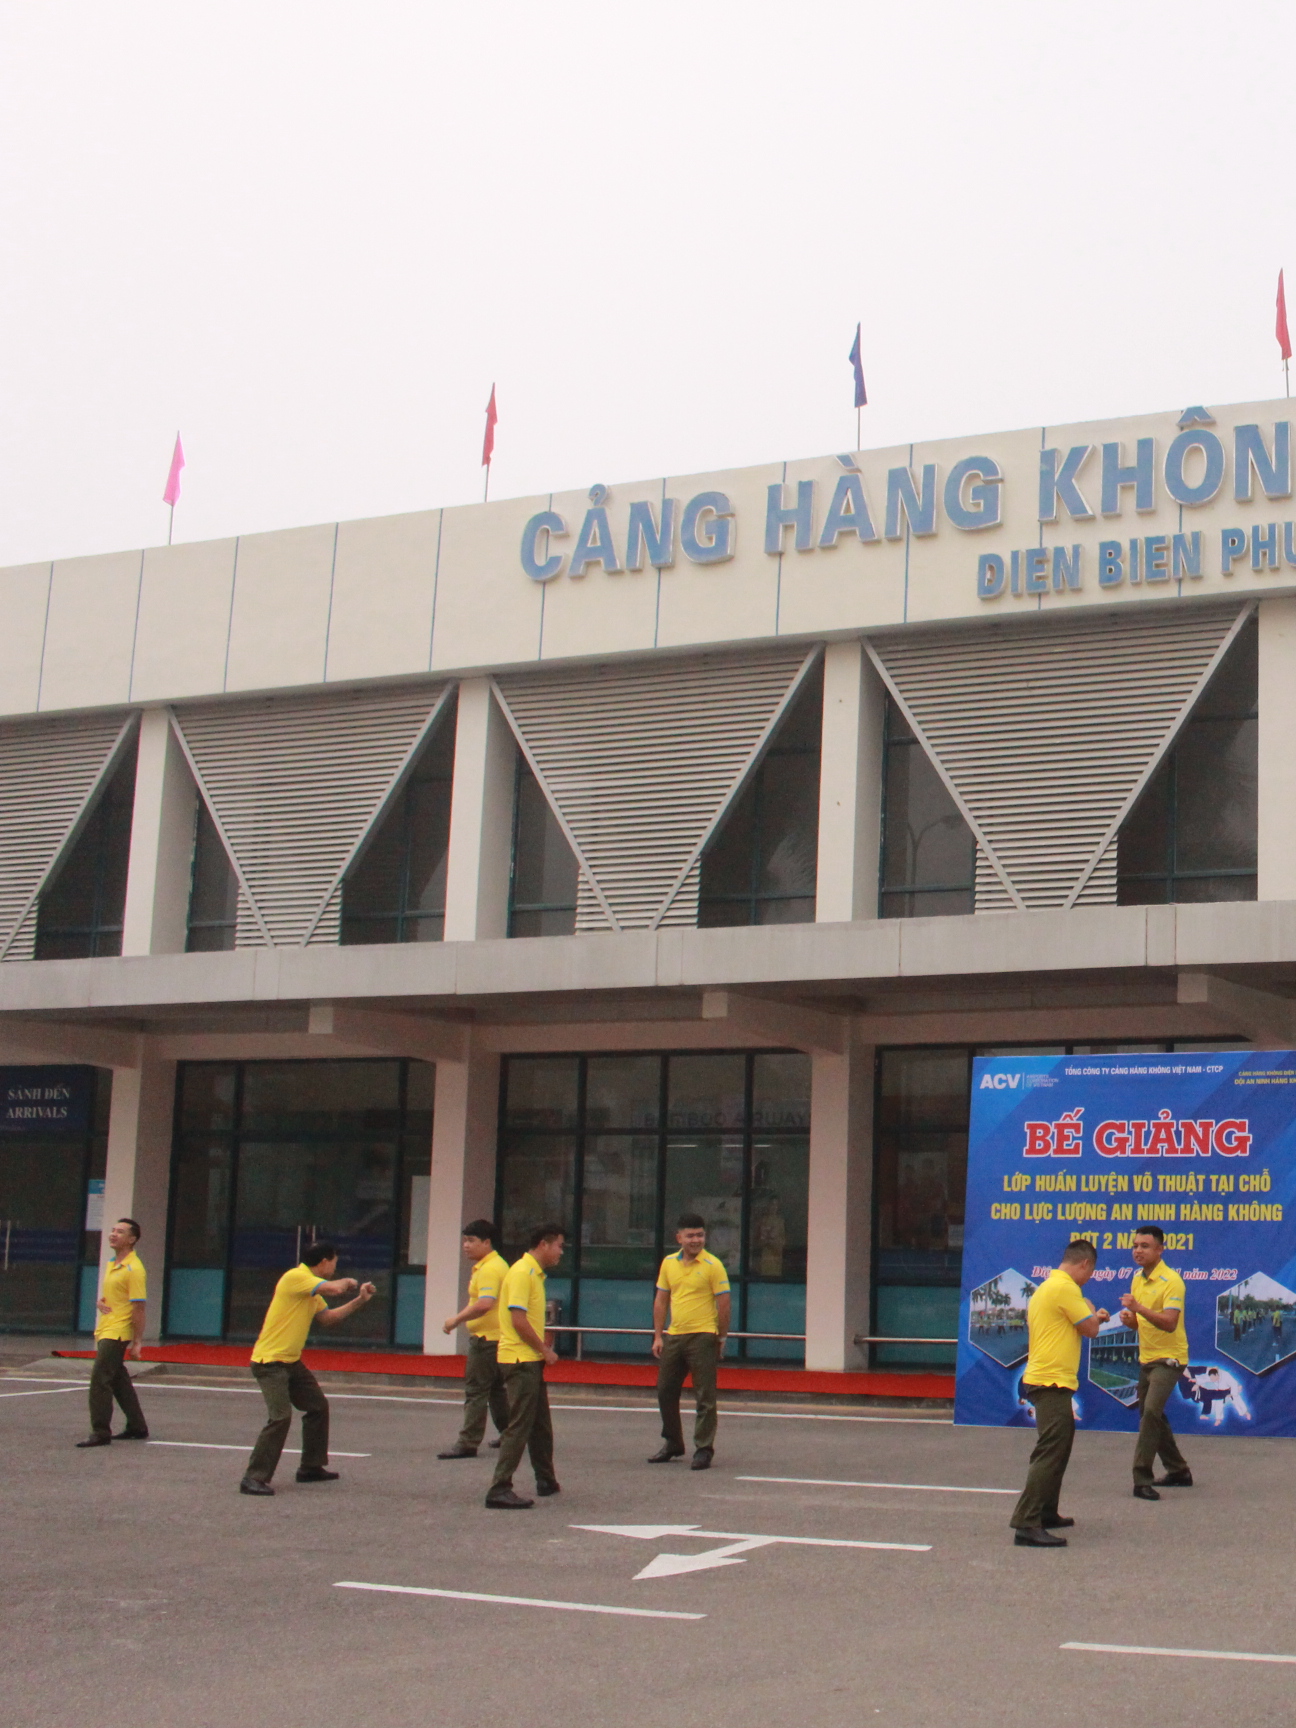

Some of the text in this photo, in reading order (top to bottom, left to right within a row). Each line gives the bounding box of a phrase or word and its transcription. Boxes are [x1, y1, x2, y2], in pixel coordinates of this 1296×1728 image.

[520, 483, 738, 583] CẢNG
[764, 453, 1004, 555] HÀNG
[977, 543, 1083, 600] DIEN
[1100, 531, 1204, 587] BIEN
[1083, 1066, 1100, 1075] CÔNG
[1102, 1067, 1109, 1075] TY
[1172, 1064, 1185, 1075] VIỆT
[1187, 1065, 1201, 1073] NAM
[1207, 1065, 1223, 1073] CTCP
[980, 1073, 1021, 1089] ACV
[7, 1106, 68, 1118] ARRIVALS
[1023, 1108, 1252, 1157] BẾ GIẢNG
[1003, 1168, 1271, 1195] LỚP HUẤN LUYỆN VÕ THUẬT TẠI CHỖ
[991, 1200, 1283, 1224] CHO LỰC LƯỢNG AN NINH HÀNG KHÔNG
[1102, 1232, 1113, 1249] 2
[1163, 1233, 1194, 1250] 2021
[1090, 1266, 1116, 1281] ngày
[1118, 1267, 1133, 1279] 07
[1183, 1267, 1208, 1280] năm
[1210, 1267, 1238, 1281] 2022
